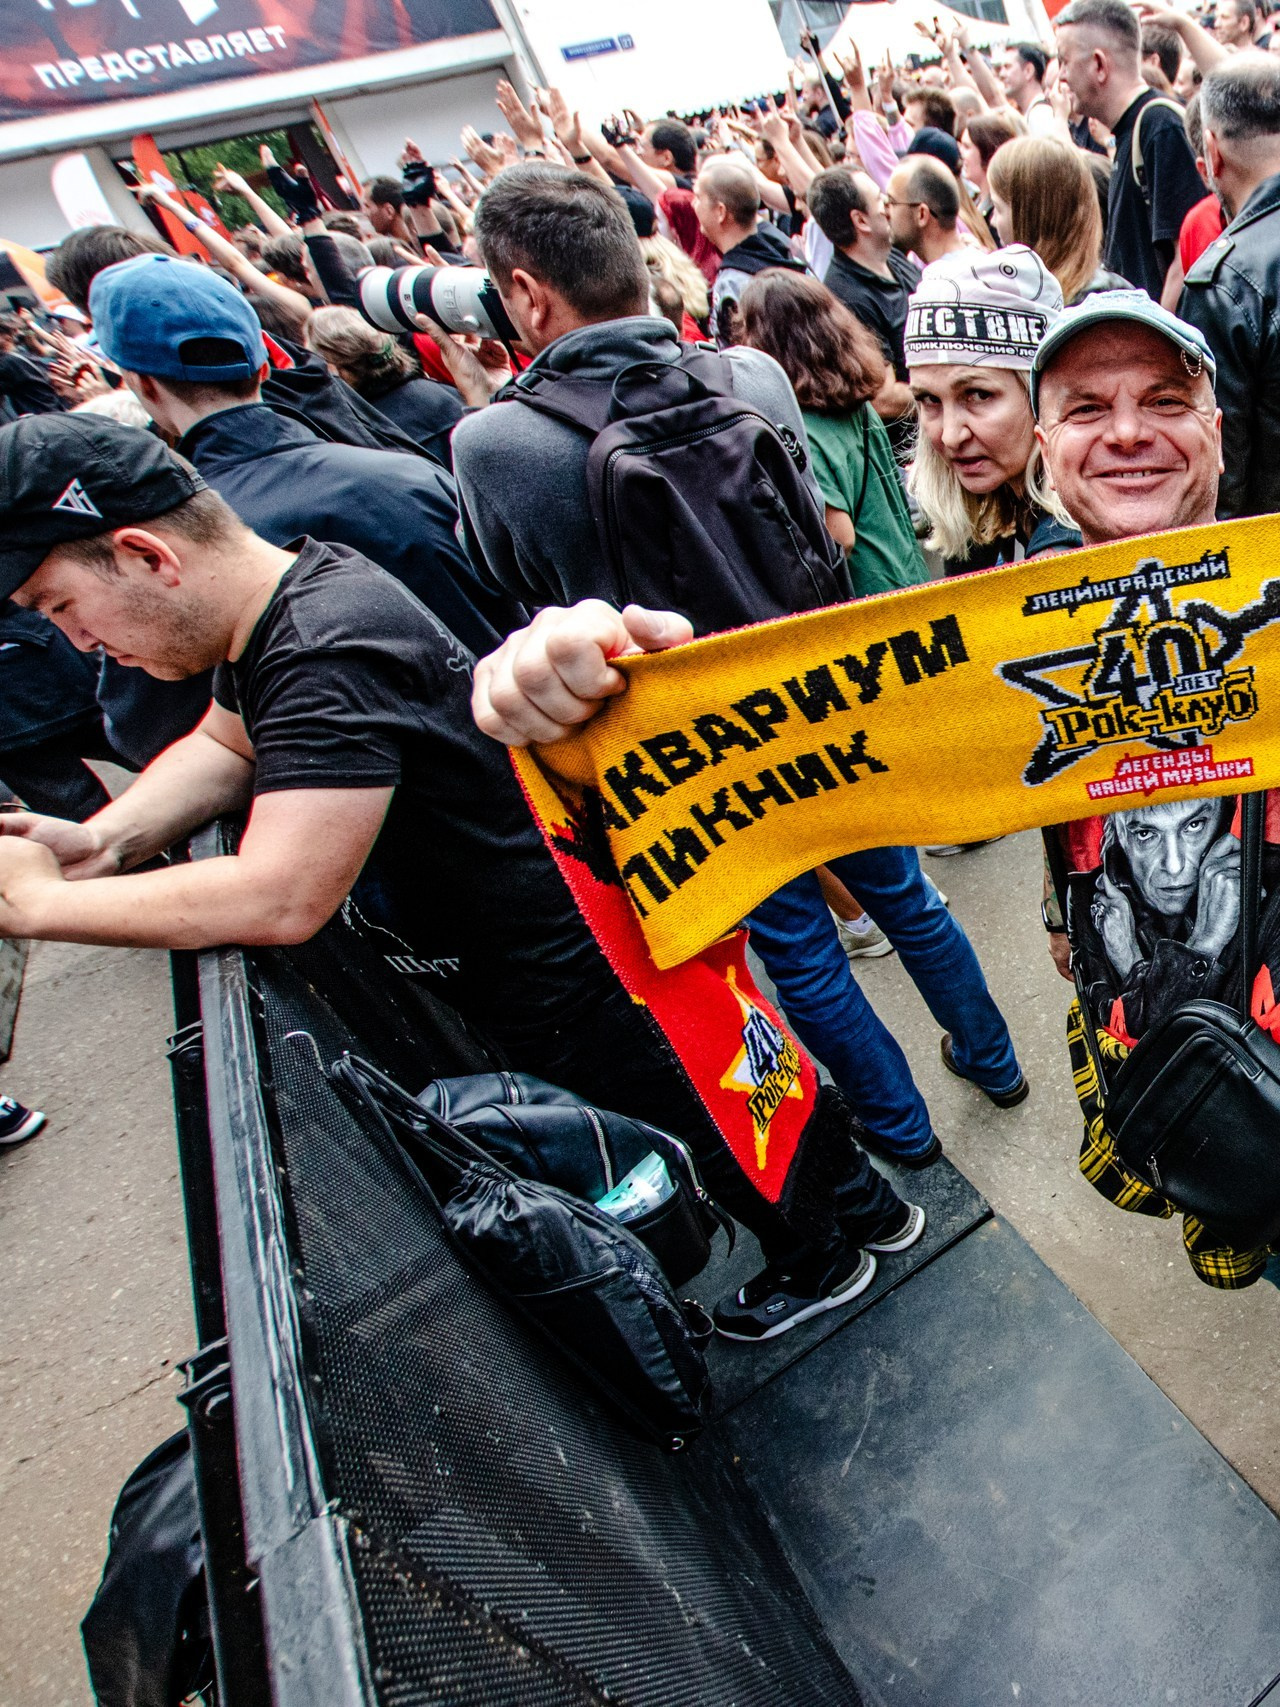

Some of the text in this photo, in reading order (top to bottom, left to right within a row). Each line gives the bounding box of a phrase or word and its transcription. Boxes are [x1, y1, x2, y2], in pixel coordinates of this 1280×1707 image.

[31, 25, 288, 89] ПРЕДСТАВЛЯЕТ
[910, 342, 1016, 355] приключение
[1019, 348, 1037, 358] ле
[1032, 555, 1227, 611] ЛЕНИНГРАДСКИЙ
[1091, 622, 1204, 704] 40
[1174, 670, 1223, 696] ЛЕТ
[1088, 761, 1253, 798] НАШЕЙ МУЗЫКИ
[1117, 747, 1212, 777] ЛЕГЕНДЫ
[622, 730, 890, 919] ПИКНИК
